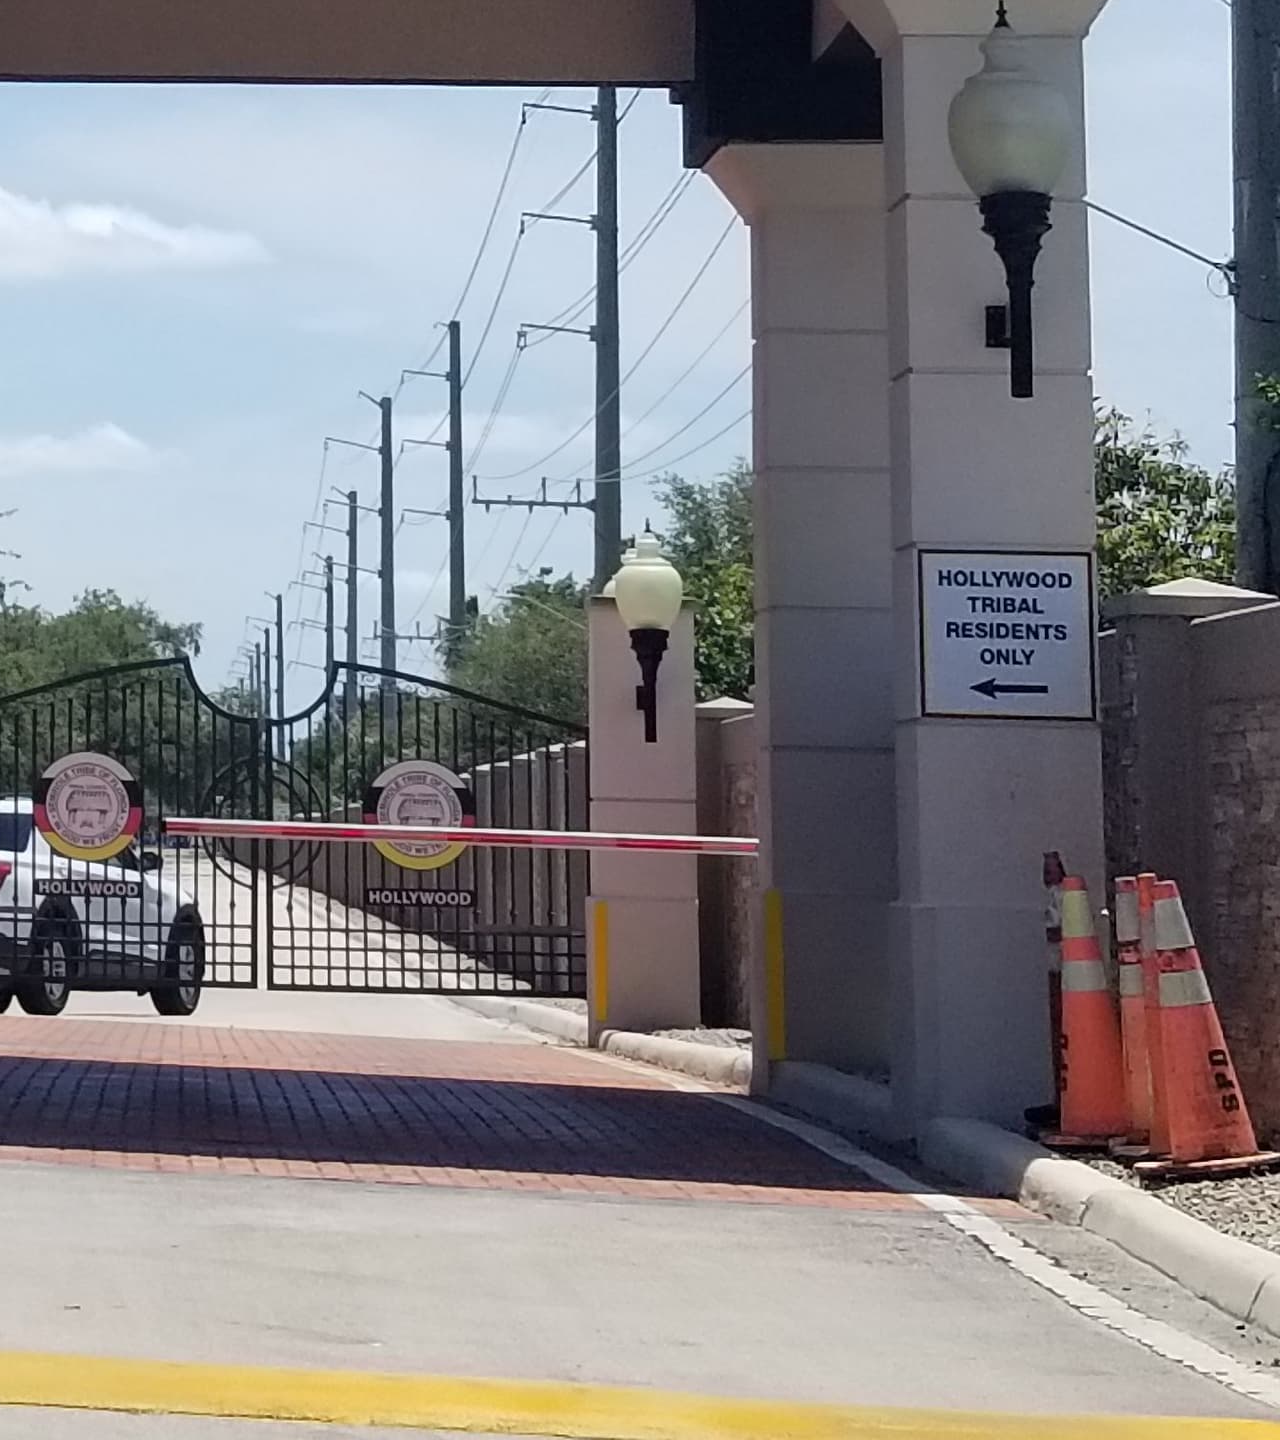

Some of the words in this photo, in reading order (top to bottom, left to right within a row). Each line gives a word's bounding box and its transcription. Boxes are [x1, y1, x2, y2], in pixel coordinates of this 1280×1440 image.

[938, 570, 1072, 588] HOLLYWOOD
[967, 596, 1044, 614] TRIBAL
[946, 622, 1067, 640] RESIDENTS
[980, 648, 1035, 665] ONLY
[402, 774, 428, 785] TRIBE
[429, 776, 442, 786] OF
[48, 773, 69, 812] SEMINOLE
[71, 766, 96, 777] TRIBE
[99, 767, 112, 778] OF
[112, 774, 128, 814] FLORIDA
[39, 880, 138, 896] HOLLYWOOD
[369, 890, 471, 905] HOLLYWOOD
